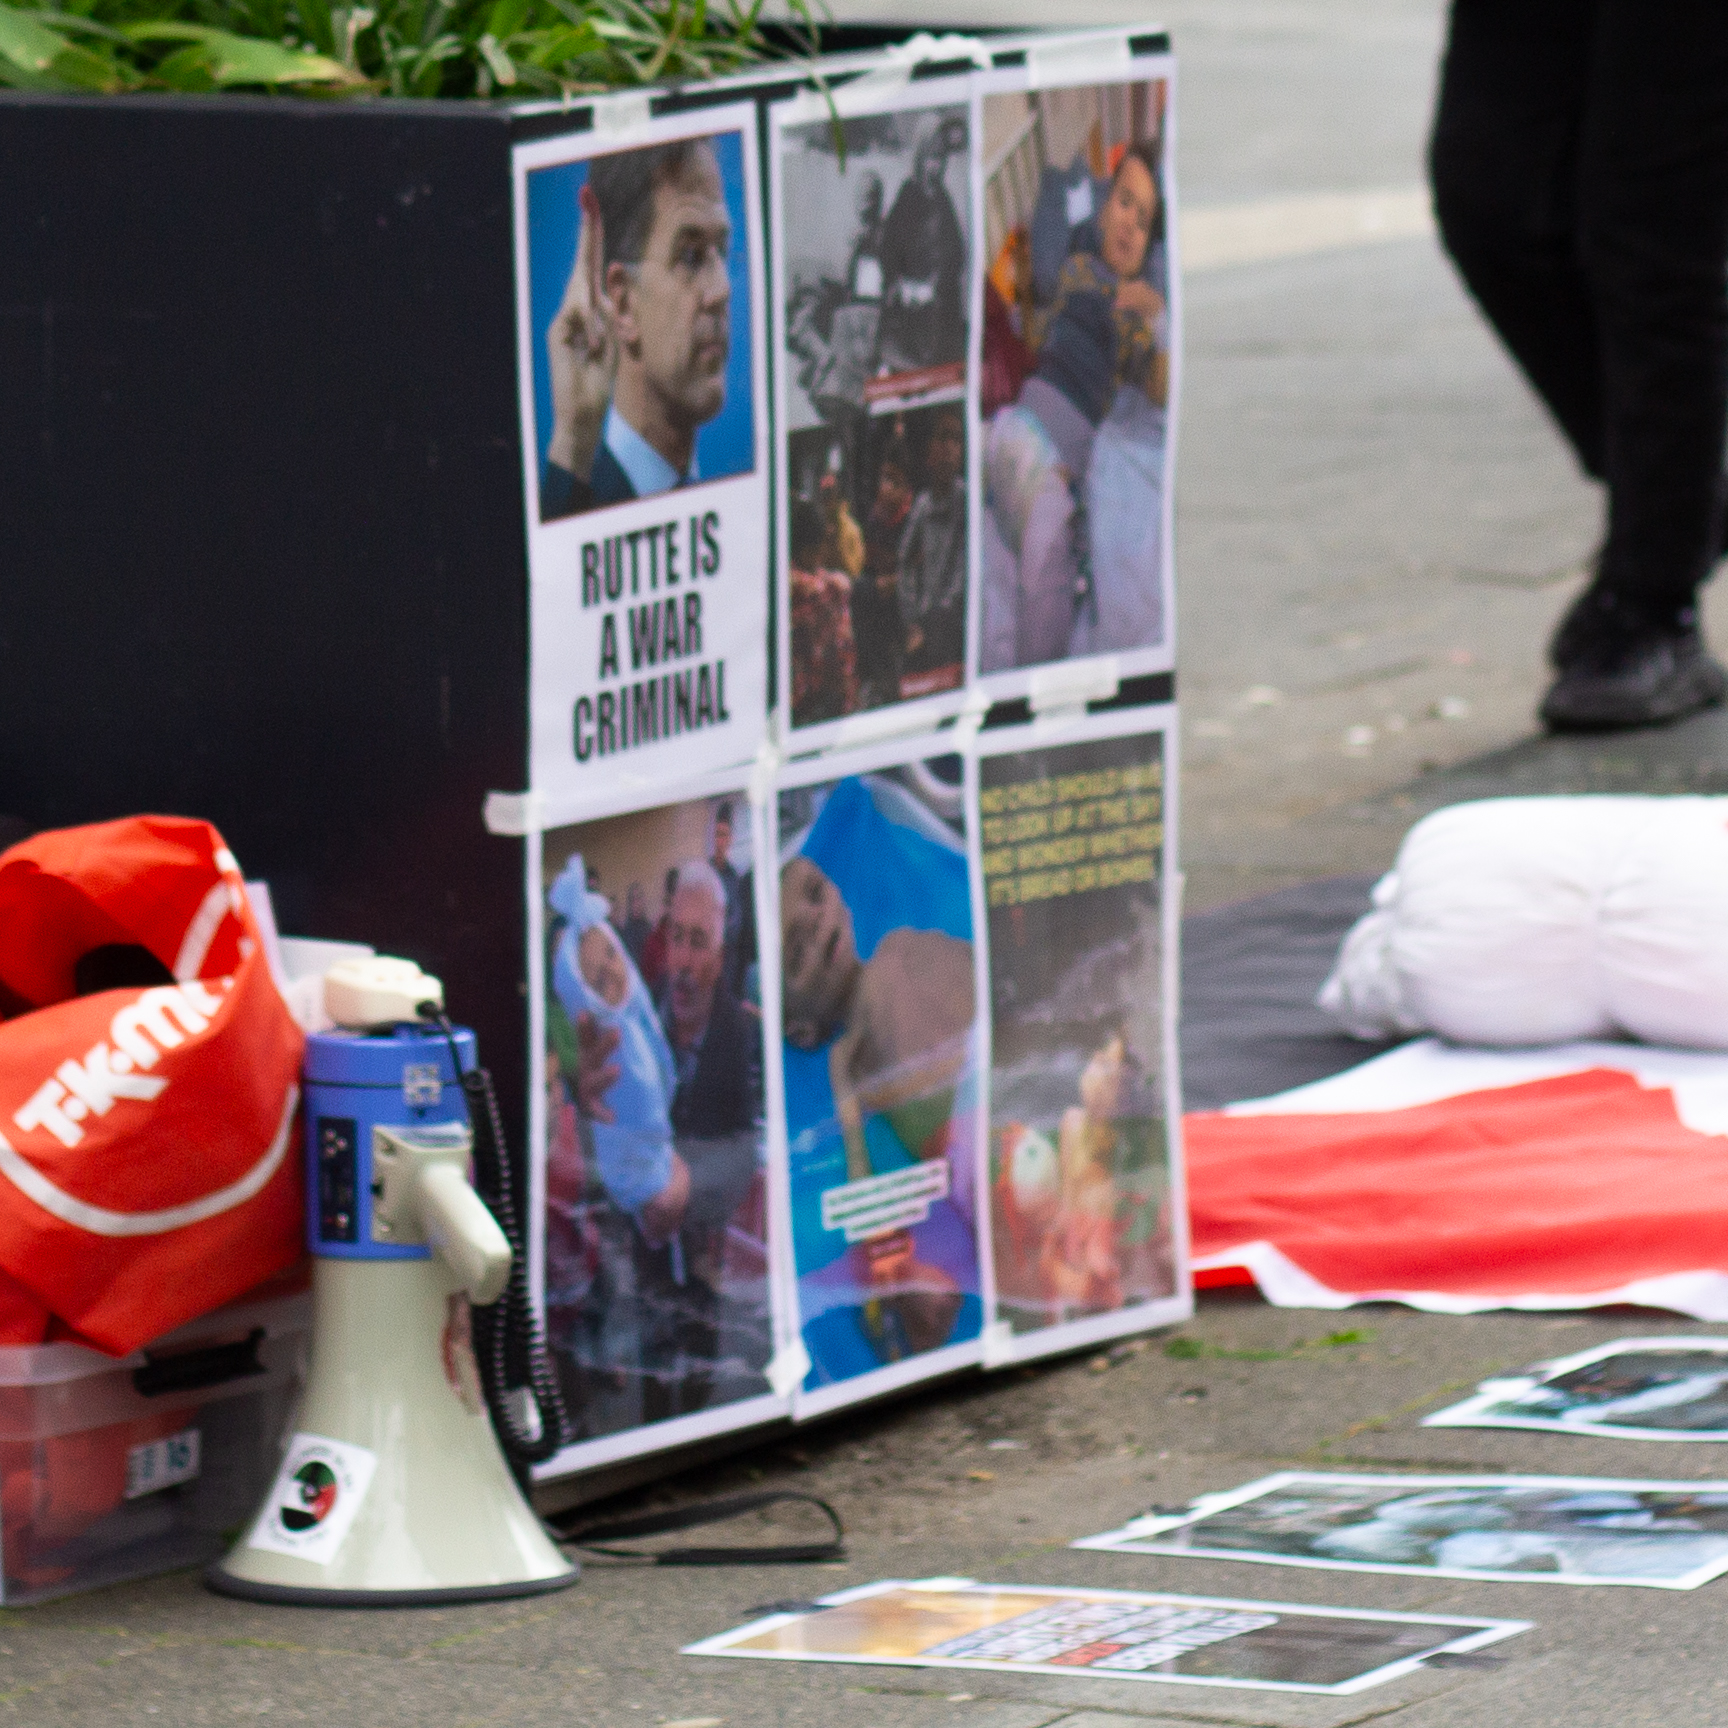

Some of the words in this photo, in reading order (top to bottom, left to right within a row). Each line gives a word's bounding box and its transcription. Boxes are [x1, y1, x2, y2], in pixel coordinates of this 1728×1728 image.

[581, 521, 679, 608] RUTTE
[689, 511, 721, 580] IS
[599, 613, 619, 679] A
[628, 591, 703, 670] WAR
[572, 658, 731, 763] CRIMINAL
